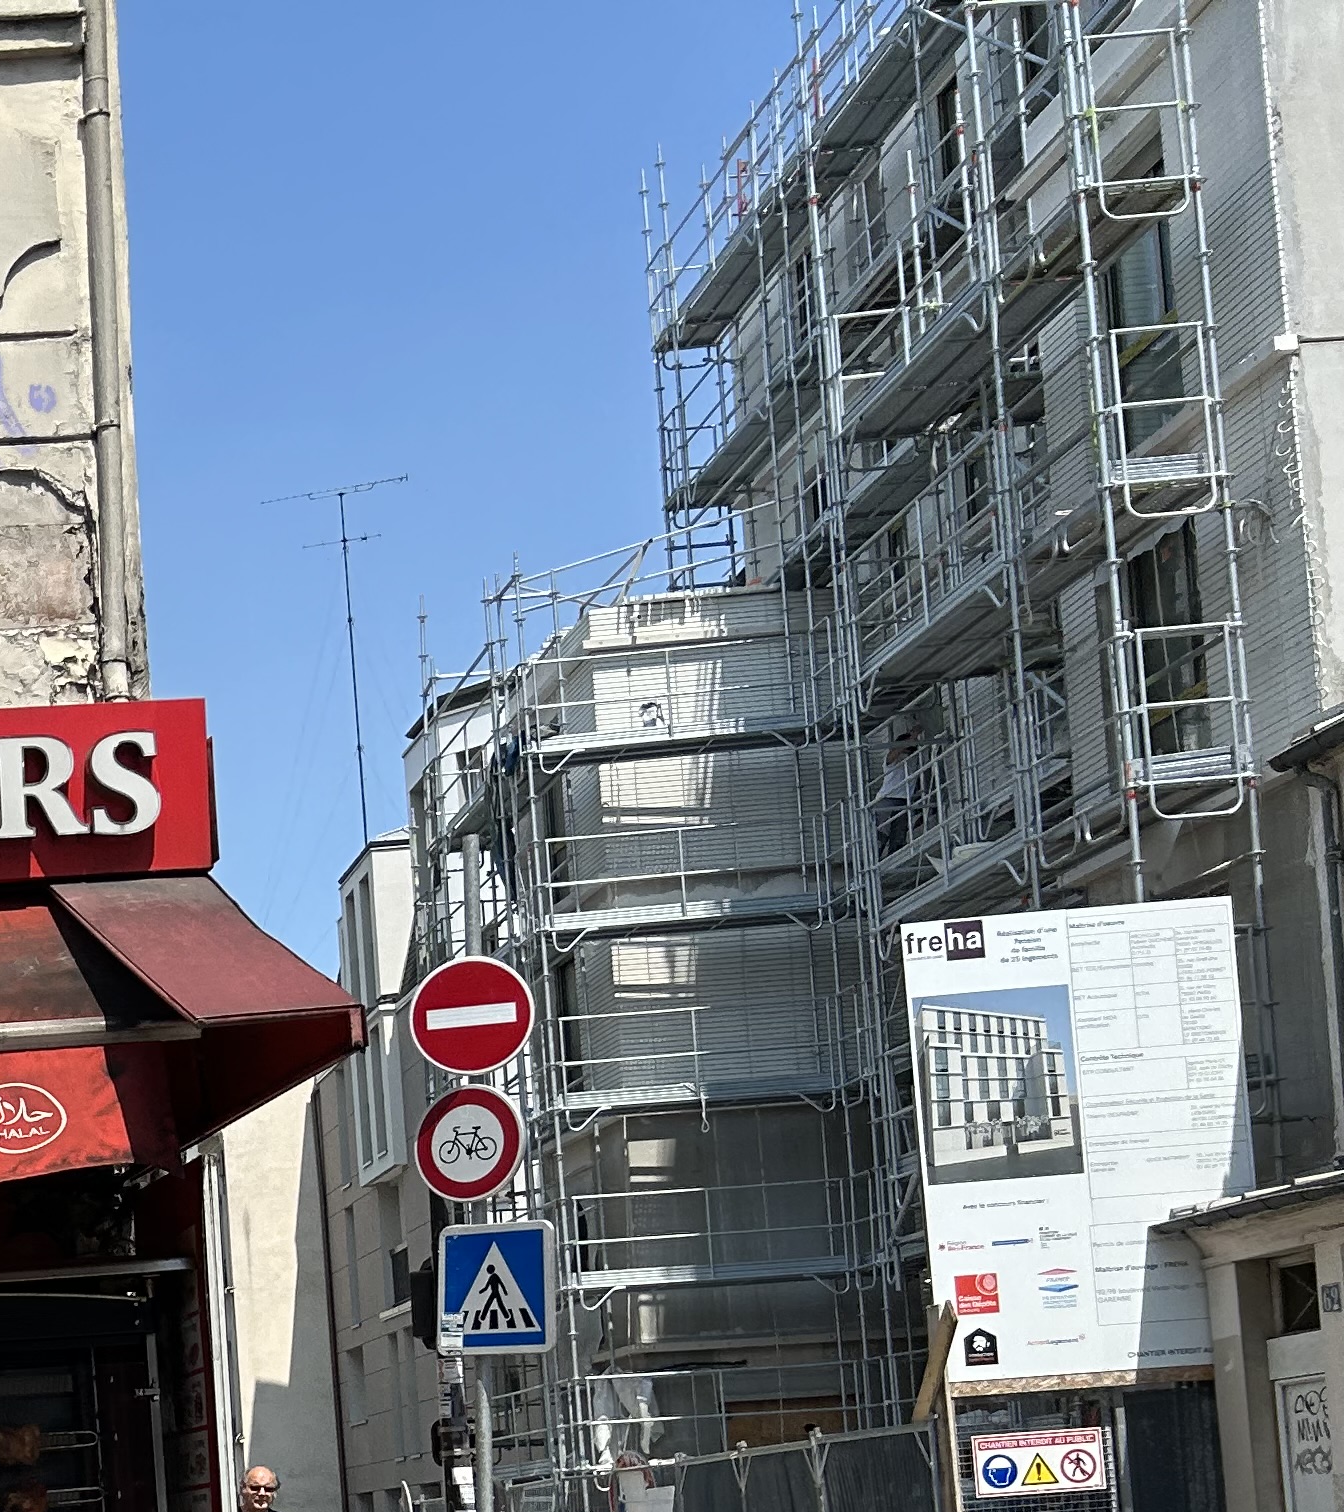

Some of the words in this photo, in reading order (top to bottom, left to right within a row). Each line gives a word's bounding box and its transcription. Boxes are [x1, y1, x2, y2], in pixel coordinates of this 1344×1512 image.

[904, 928, 983, 954] freha
[979, 1440, 1017, 1450] CHANTIER
[1018, 1437, 1053, 1447] INTERDIT
[1054, 1436, 1064, 1444] AU
[1066, 1434, 1095, 1443] PUBLIC
